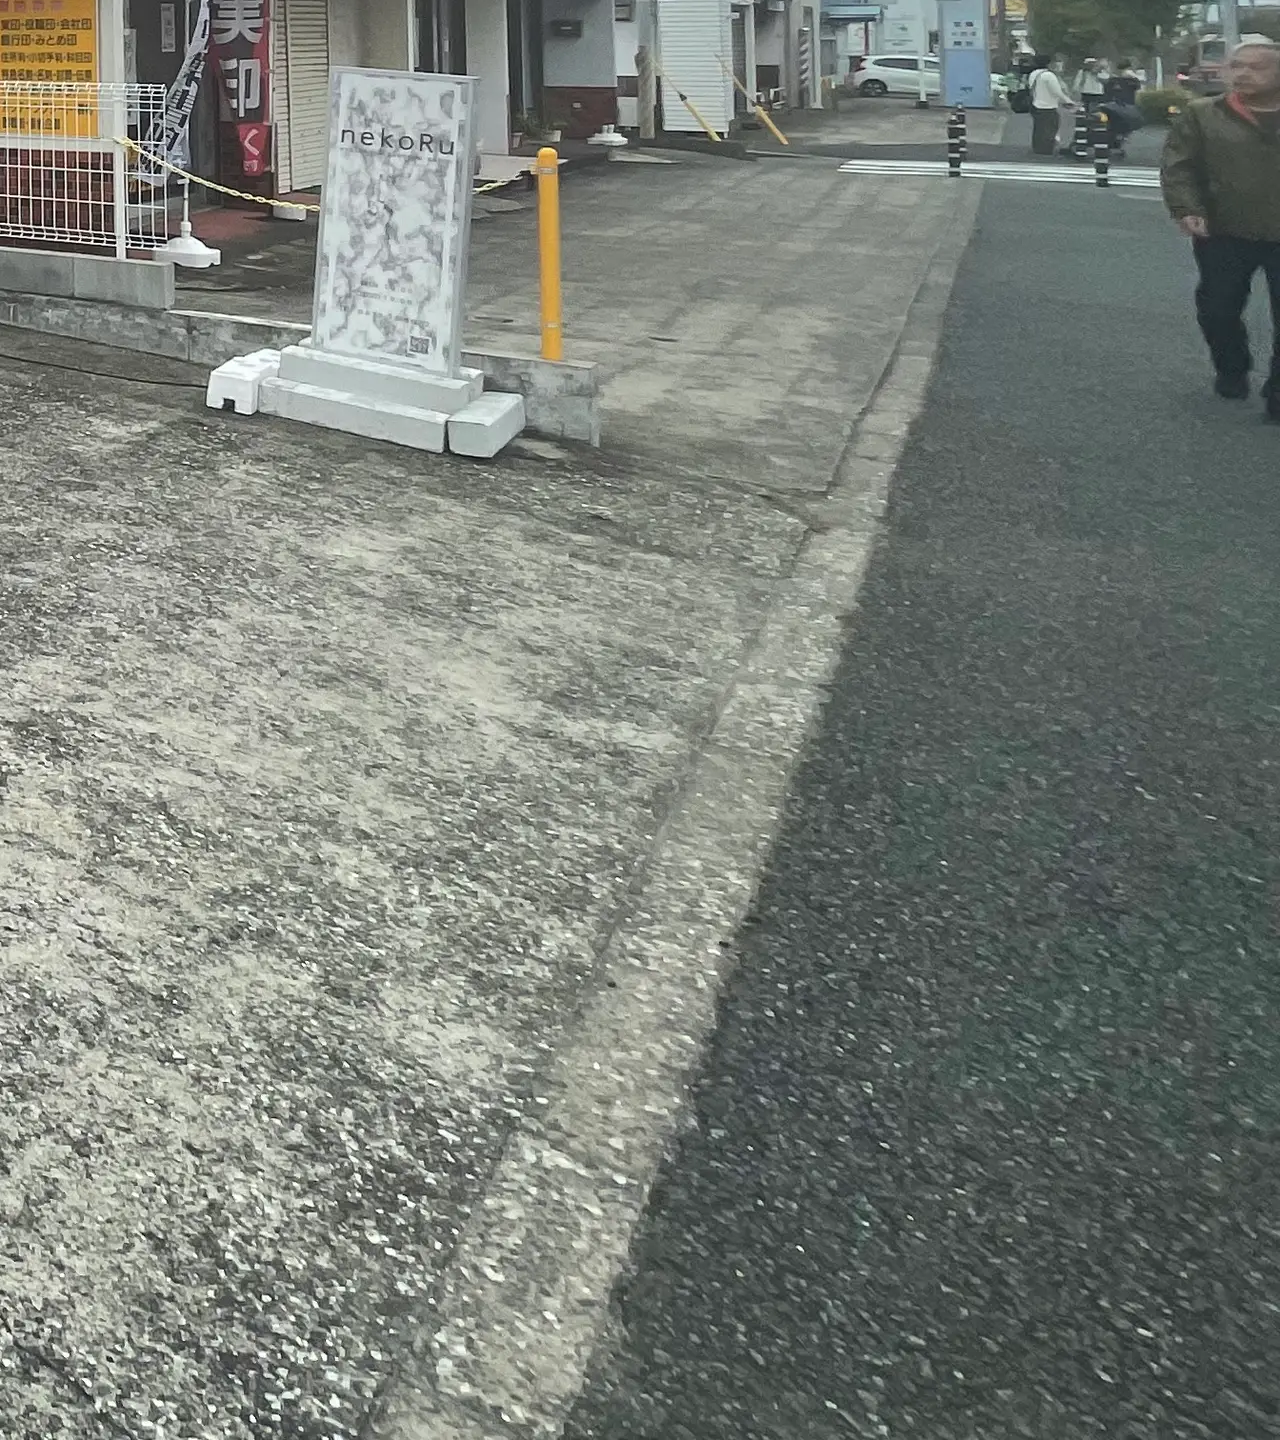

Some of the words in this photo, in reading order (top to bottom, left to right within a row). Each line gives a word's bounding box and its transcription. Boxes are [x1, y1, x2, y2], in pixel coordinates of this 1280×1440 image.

[1, 33, 78, 46] 行印・みとめ印
[340, 127, 455, 156] nekoRu
